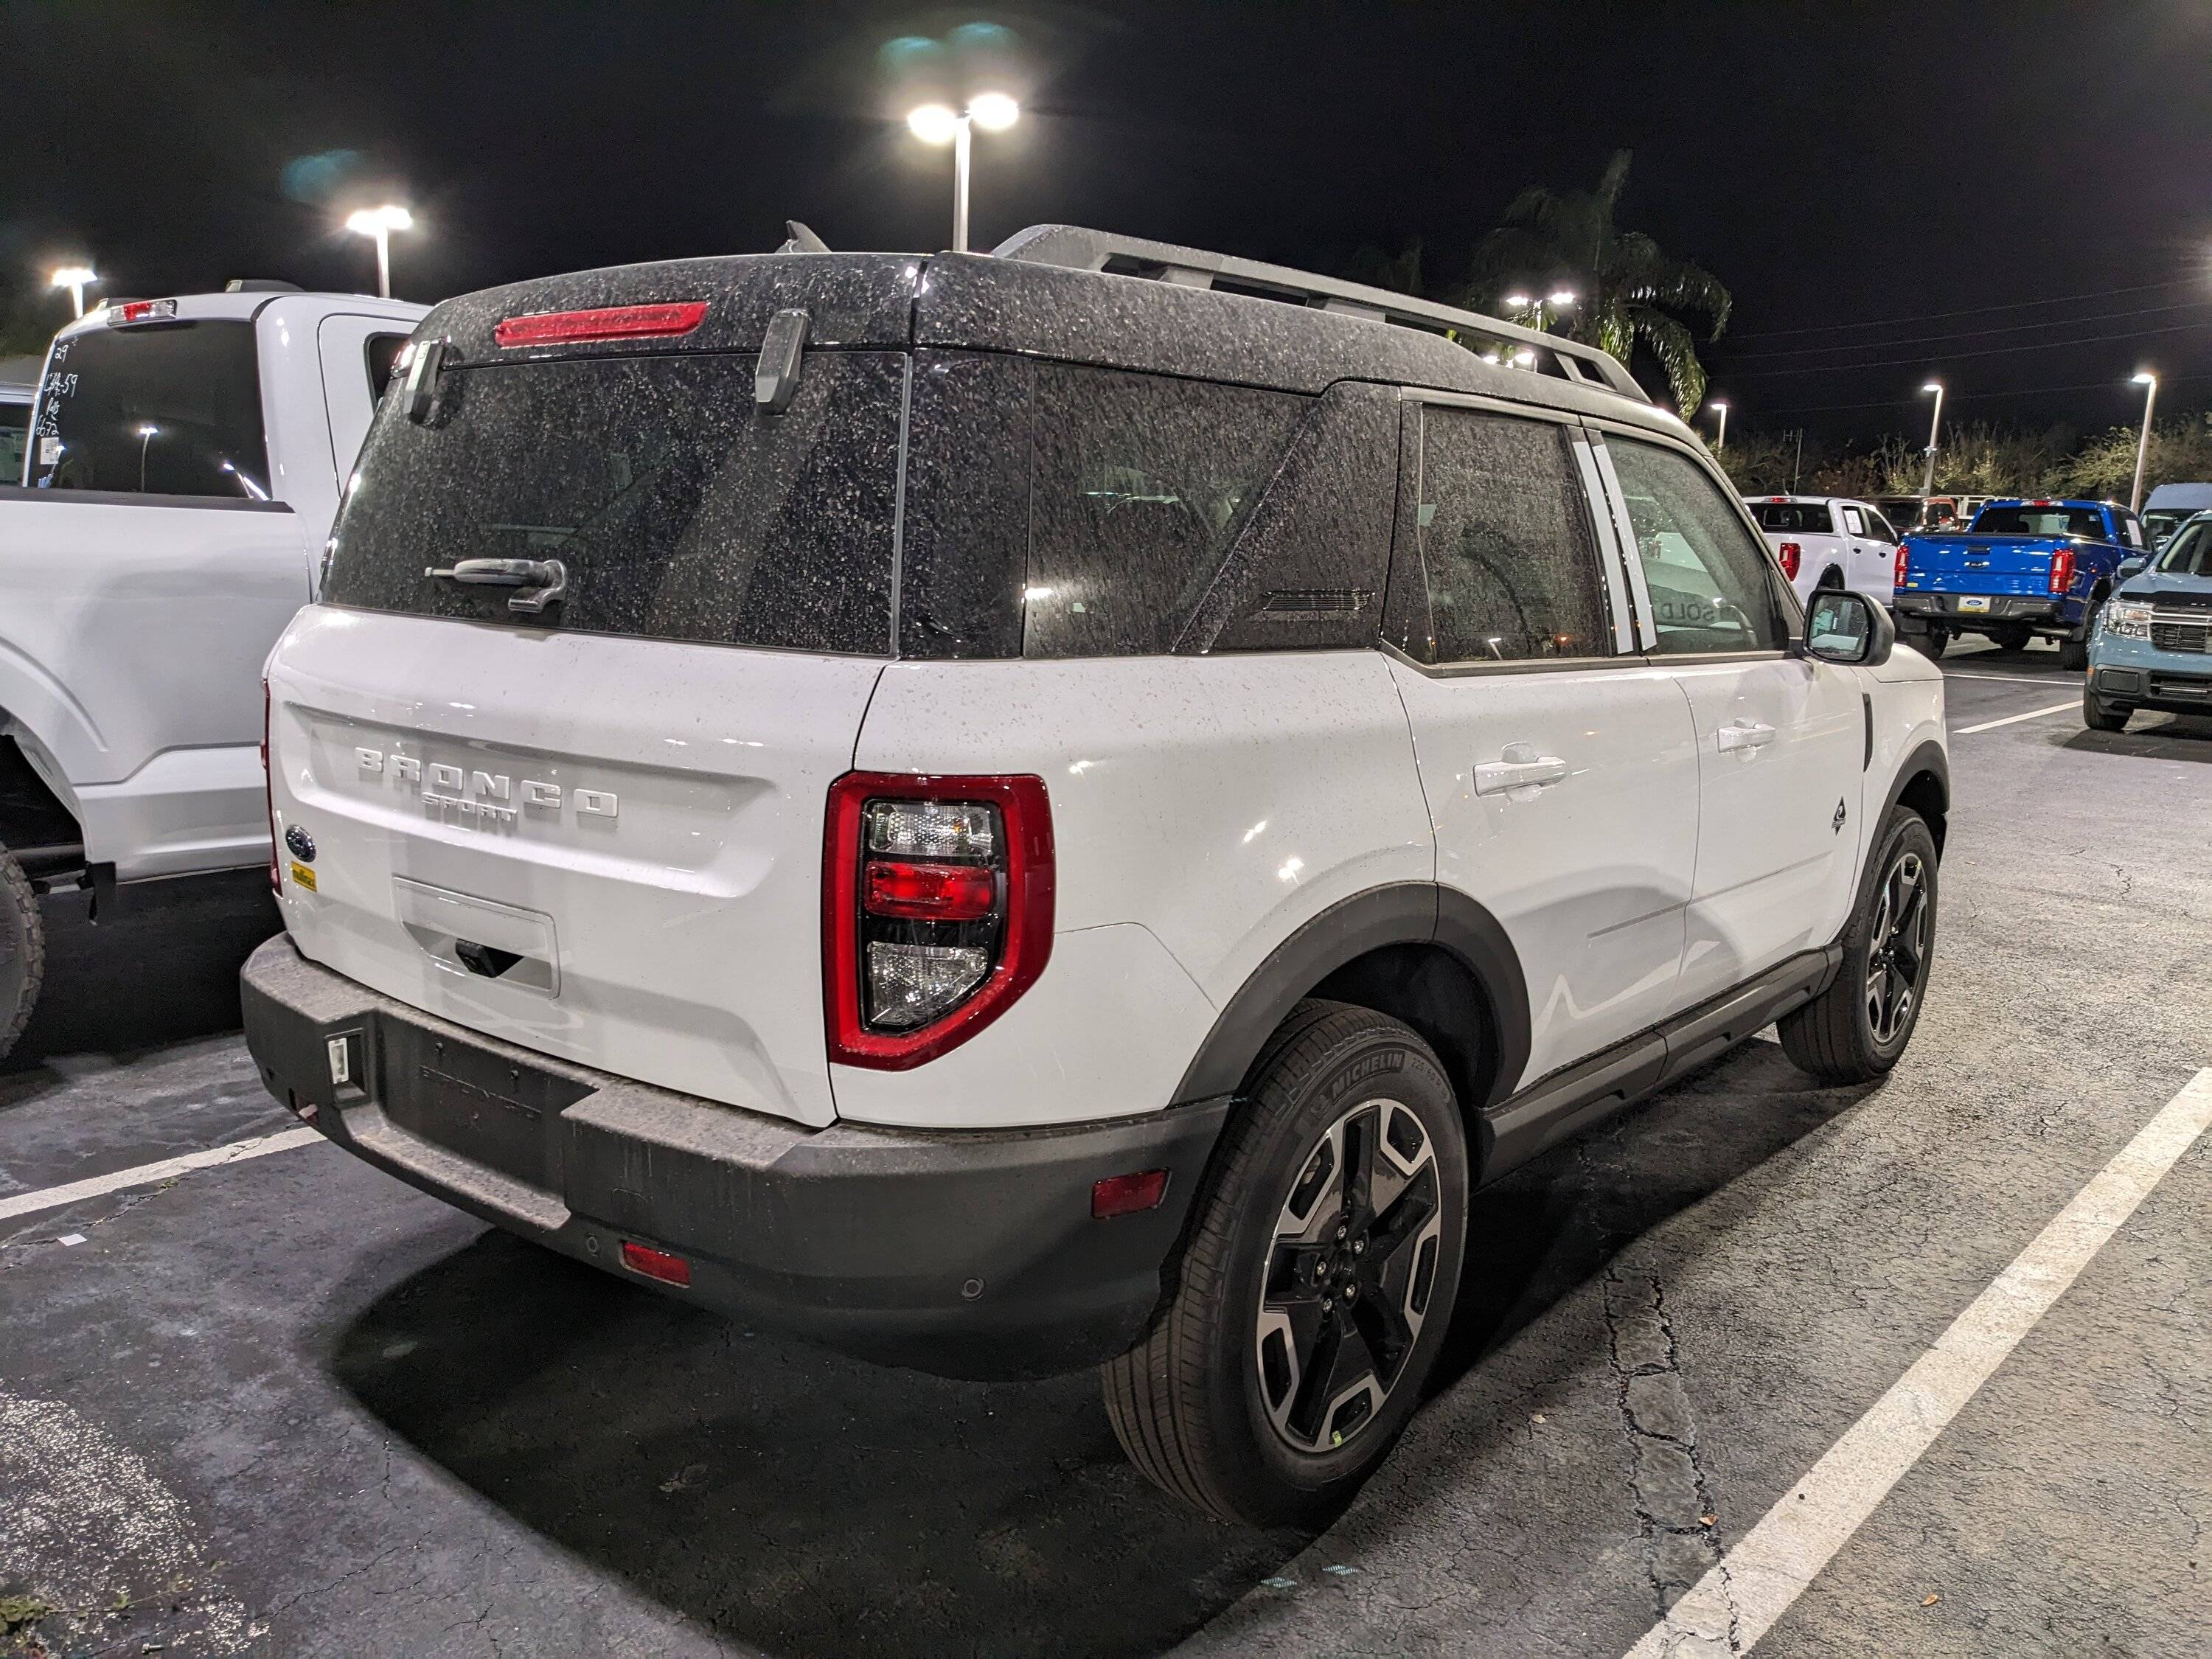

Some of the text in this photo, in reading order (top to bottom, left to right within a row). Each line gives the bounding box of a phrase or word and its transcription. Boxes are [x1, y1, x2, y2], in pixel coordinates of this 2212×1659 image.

[55, 344, 69, 362] 29
[355, 746, 619, 818] BRONCO
[422, 791, 518, 822] SPORT
[1331, 1053, 1404, 1099] MICHELIN
